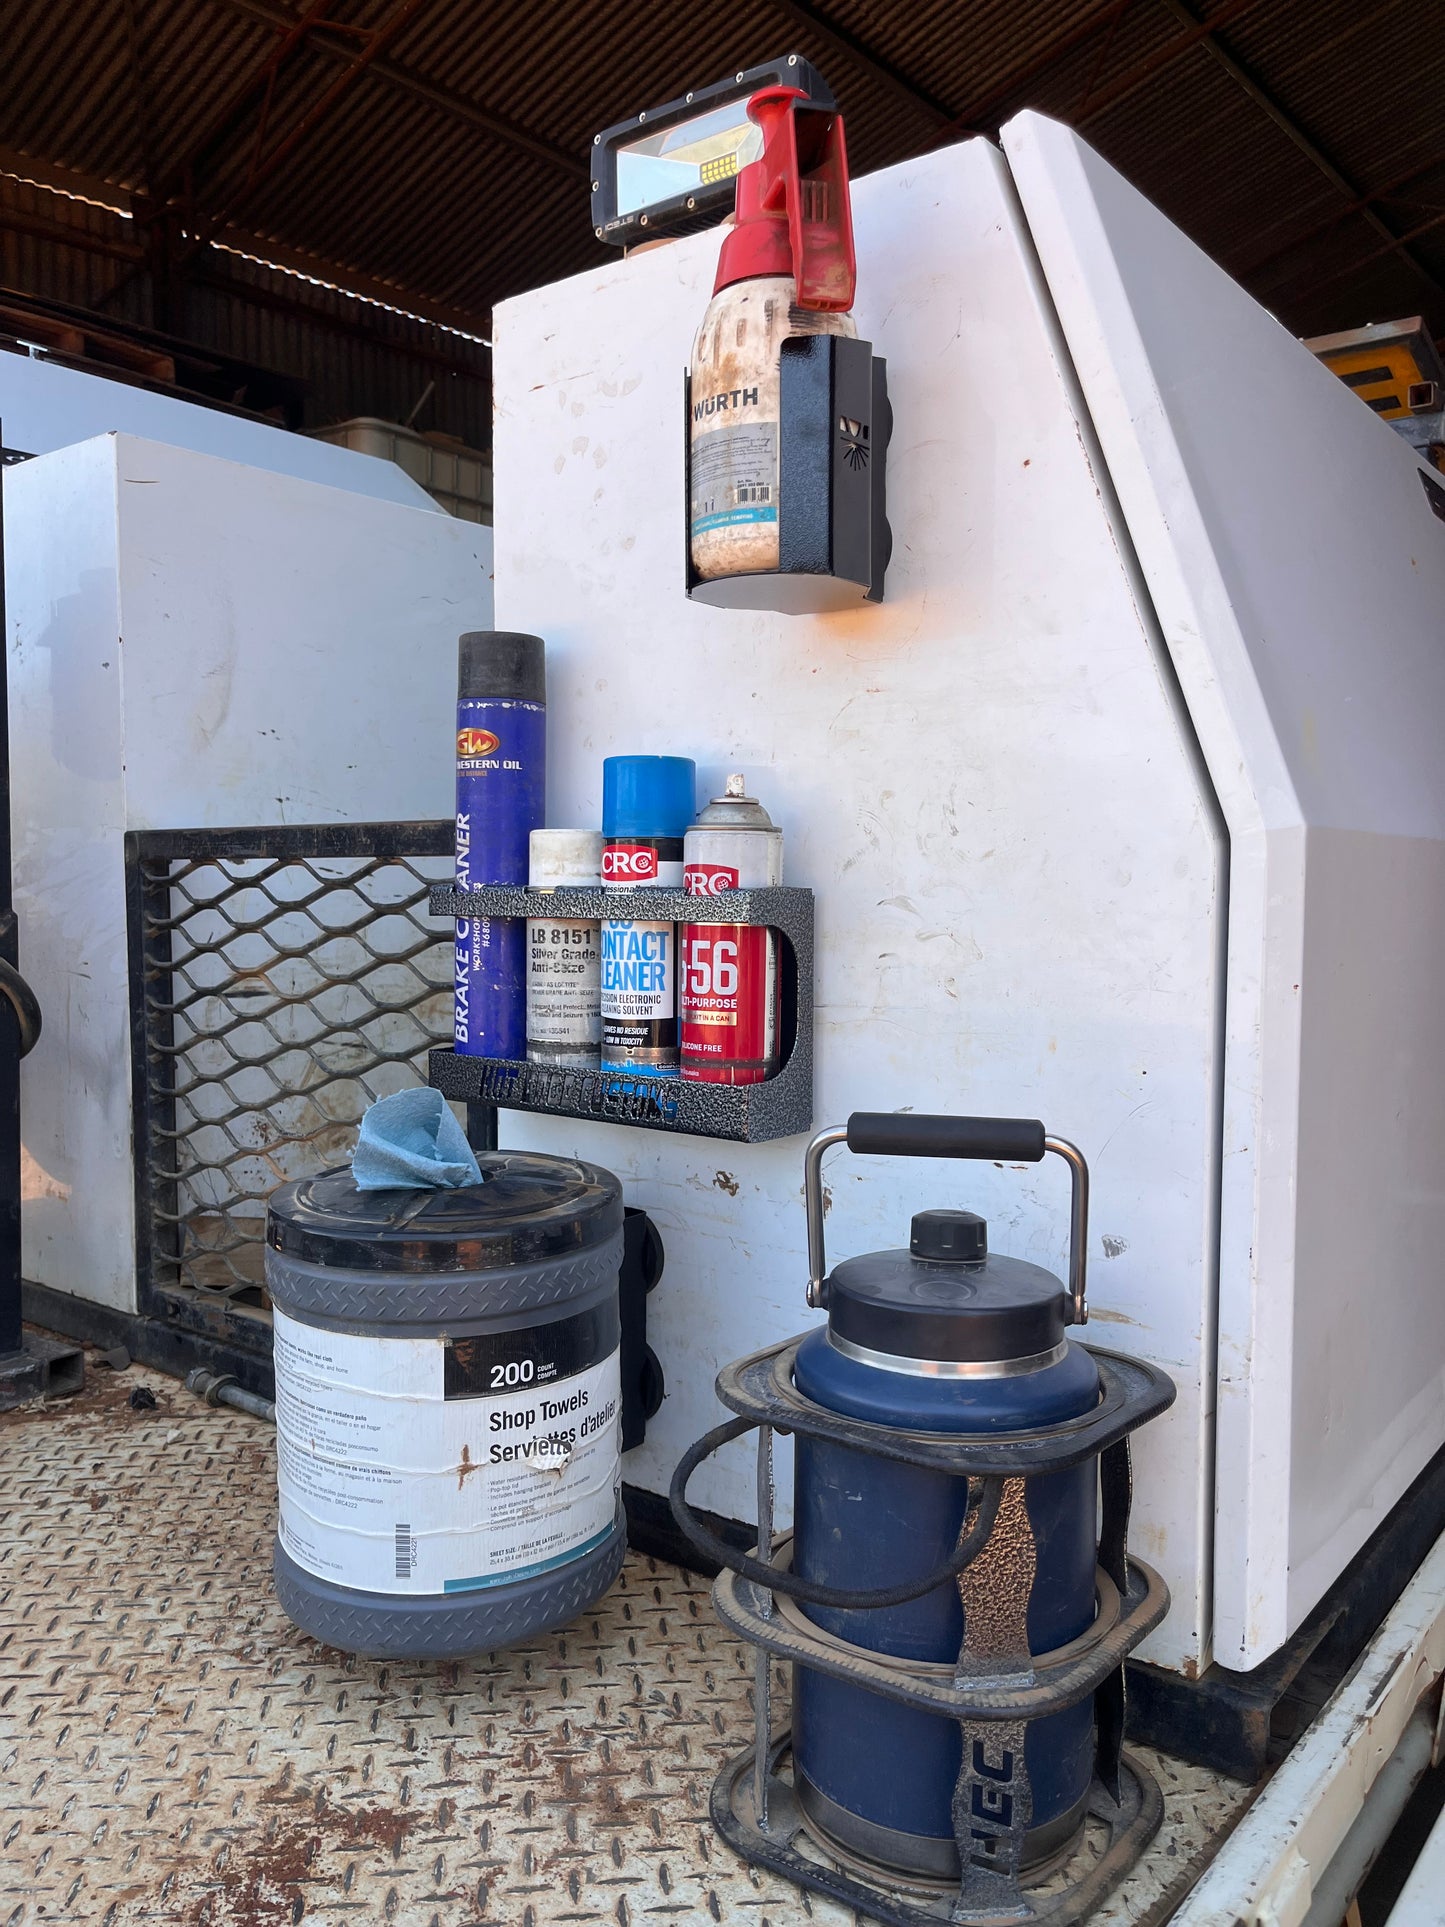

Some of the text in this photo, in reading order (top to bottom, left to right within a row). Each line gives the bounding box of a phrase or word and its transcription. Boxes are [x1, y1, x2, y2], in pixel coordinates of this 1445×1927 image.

[694, 387, 758, 422] WÜRTH
[503, 761, 523, 771] OIL
[602, 851, 653, 874] CRC
[684, 872, 733, 896] CRC
[531, 928, 546, 944] LB
[602, 930, 669, 961] ONTACT
[531, 948, 558, 960] Silver
[602, 961, 666, 992] LEANER
[456, 946, 469, 1044] BRAKE
[619, 994, 662, 1005] ELECTRONIC
[682, 996, 738, 1009] LTI-PURPOSE
[622, 1005, 654, 1016] SOLVENT
[624, 1027, 650, 1035] RESIDUE
[703, 1044, 723, 1053] FREE
[336, 1365, 349, 1375] home
[490, 1359, 555, 1389] 200 COUNT
[537, 1369, 558, 1381] COMPTE
[489, 1389, 589, 1433] Shop Towels
[366, 1424, 382, 1432] hogar
[489, 1400, 617, 1465] Serviettes d'atelier
[382, 1478, 403, 1486] maison
[490, 1478, 506, 1486] Water
[490, 1484, 511, 1493] Pop-top
[491, 1480, 552, 1500] Includes hanging bracket
[498, 1503, 507, 1511] pot
[491, 1521, 516, 1532] Comprend
[490, 1549, 504, 1558] SHEET
